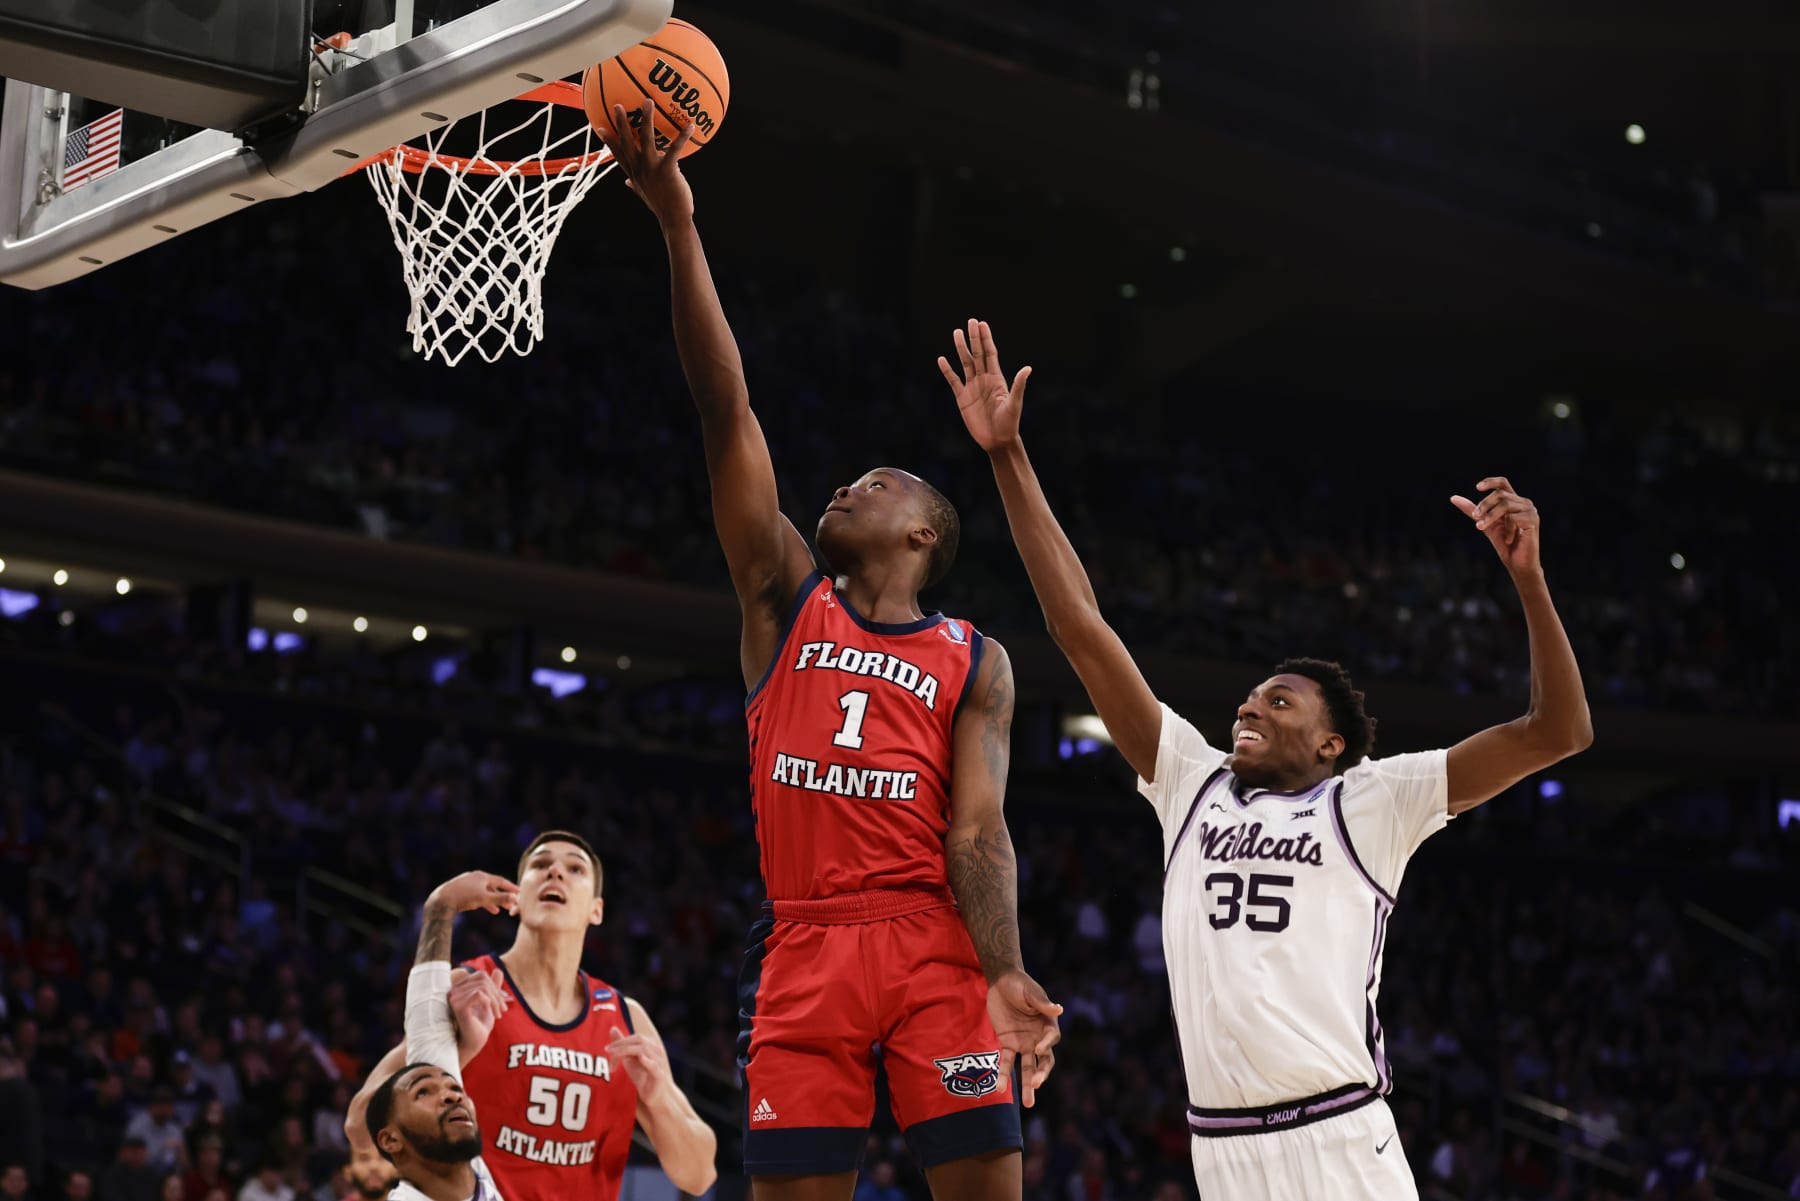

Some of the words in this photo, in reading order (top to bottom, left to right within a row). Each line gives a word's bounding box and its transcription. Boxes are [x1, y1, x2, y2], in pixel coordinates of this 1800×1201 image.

[648, 58, 714, 137] Wilson
[794, 641, 938, 710] FLORIDA
[832, 689, 870, 750] 1
[771, 752, 918, 801] ATLANTIC
[1200, 822, 1323, 866] Wildcats
[1205, 873, 1294, 933] 35
[507, 1043, 612, 1083] FLORIDA
[939, 1053, 998, 1078] FAU
[527, 1075, 592, 1131] 50
[752, 1111, 778, 1123] adidas
[496, 1125, 597, 1167] ATLANTIC
